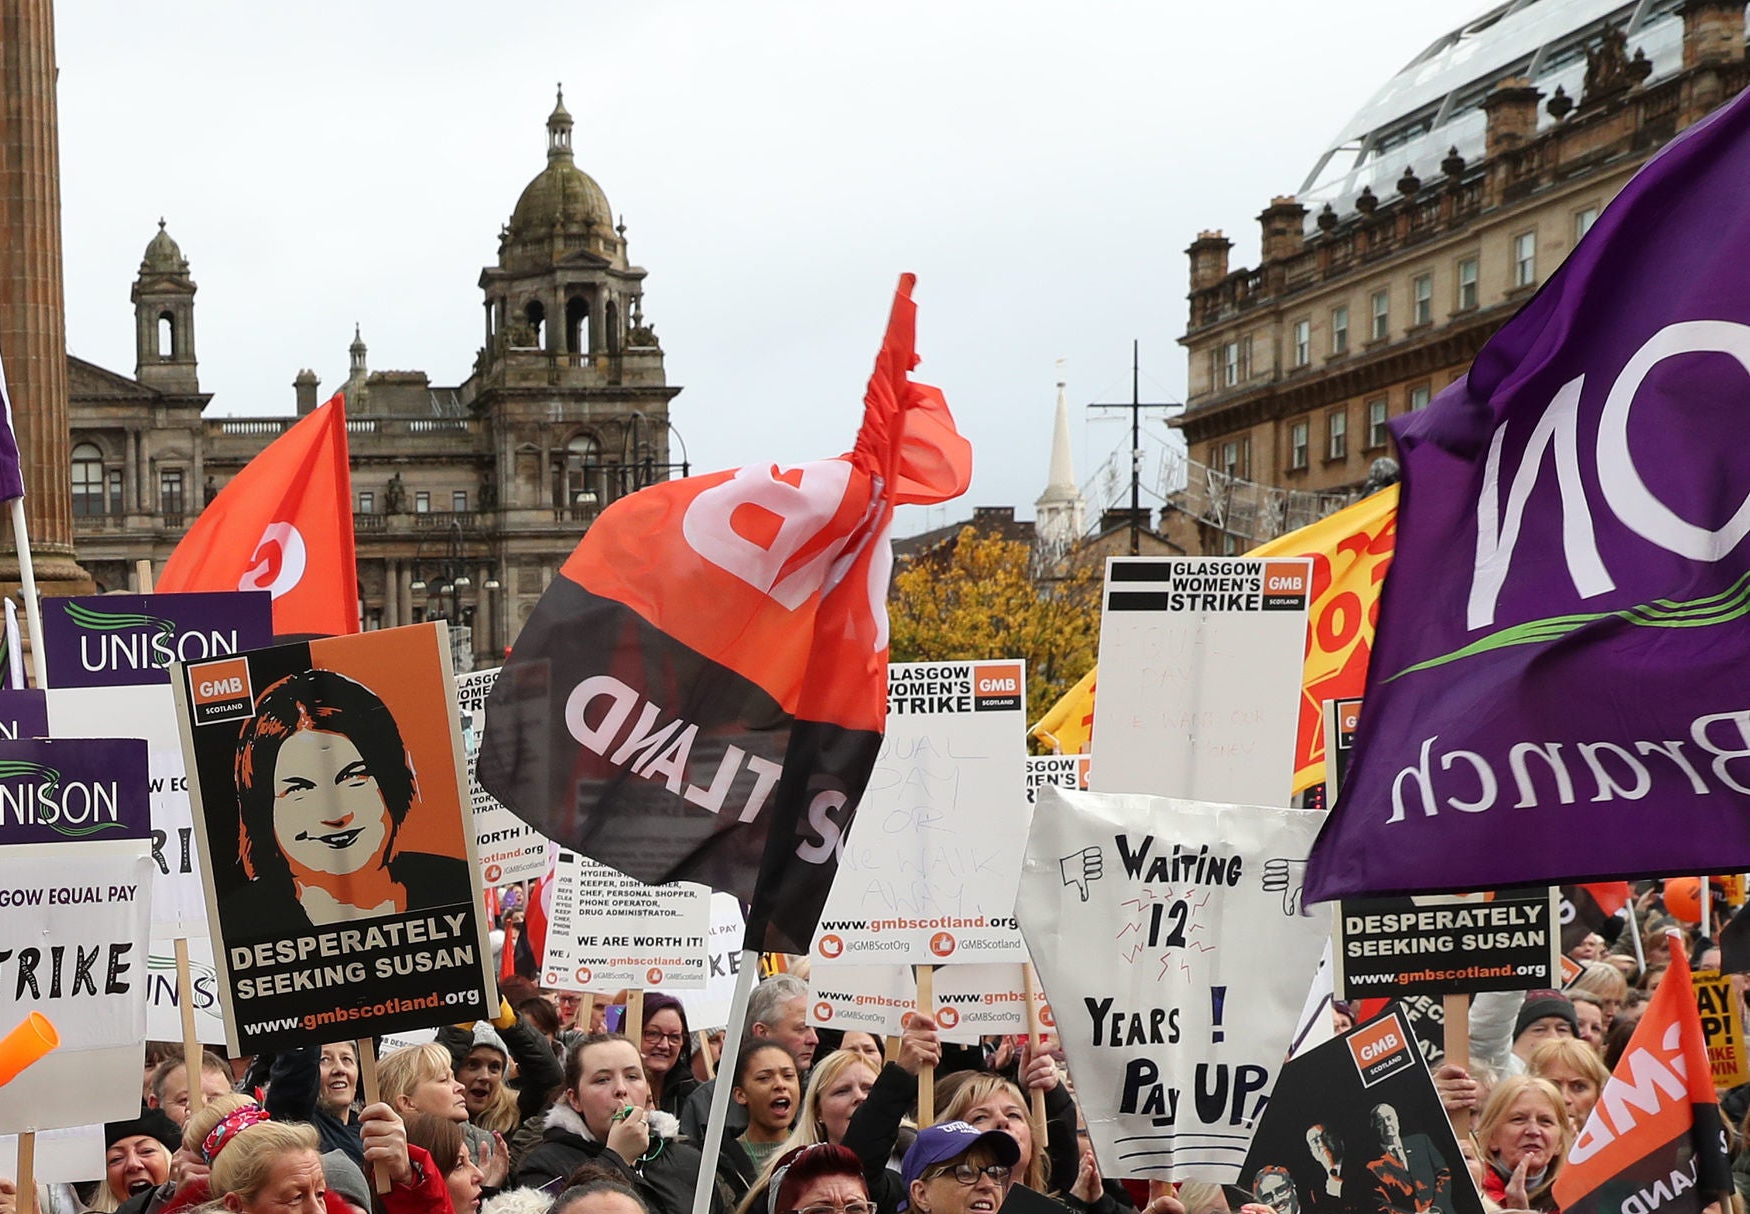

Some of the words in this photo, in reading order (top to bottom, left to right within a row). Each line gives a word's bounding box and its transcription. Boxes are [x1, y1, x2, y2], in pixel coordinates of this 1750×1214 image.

[1173, 562, 1262, 576] GLASGOW
[1172, 578, 1261, 592] WOMEN'S
[1269, 577, 1302, 591] GMB
[1170, 594, 1260, 611] STRIKE
[80, 630, 238, 672] UNISON
[888, 666, 970, 682] LASGOW
[199, 677, 243, 698] GMB
[979, 677, 1016, 692] GMB
[205, 702, 243, 715] SCOTLAND
[580, 880, 617, 888] KEEPER,
[49, 886, 103, 908] EQUAL
[108, 884, 137, 903] PAY
[580, 890, 604, 898] CHEF,
[607, 890, 652, 898] PERSONAL
[655, 890, 697, 899] SHOPPER,
[612, 899, 660, 907] OPERATOR,
[821, 915, 1018, 933] www.gmbscotland.org
[1148, 900, 1188, 948] 12
[1346, 905, 1542, 936] DESPERATELY
[231, 913, 467, 972] DESPERATELY
[577, 936, 598, 946] WE
[602, 936, 629, 946] ARE
[633, 937, 682, 947] WORTH
[686, 937, 703, 947] IT!
[846, 940, 910, 952] @GMBScotOrg
[958, 938, 1020, 951] /GMBScotland
[1348, 935, 1454, 957] SEEKING
[1462, 930, 1545, 951] SUSAN
[578, 956, 702, 968] www.gmbscotland.org
[237, 960, 367, 1001] SEEKING
[375, 944, 475, 978] SUSAN
[1350, 962, 1546, 986] www.gmbscotland.org
[818, 990, 916, 1009] www.gmbscot
[1701, 984, 1730, 1015] AY
[244, 986, 480, 1036] www.gmbscotland.org
[1084, 997, 1181, 1047] YEARS
[1360, 1033, 1398, 1061] GMB
[1370, 1055, 1402, 1075] SCOTLAND
